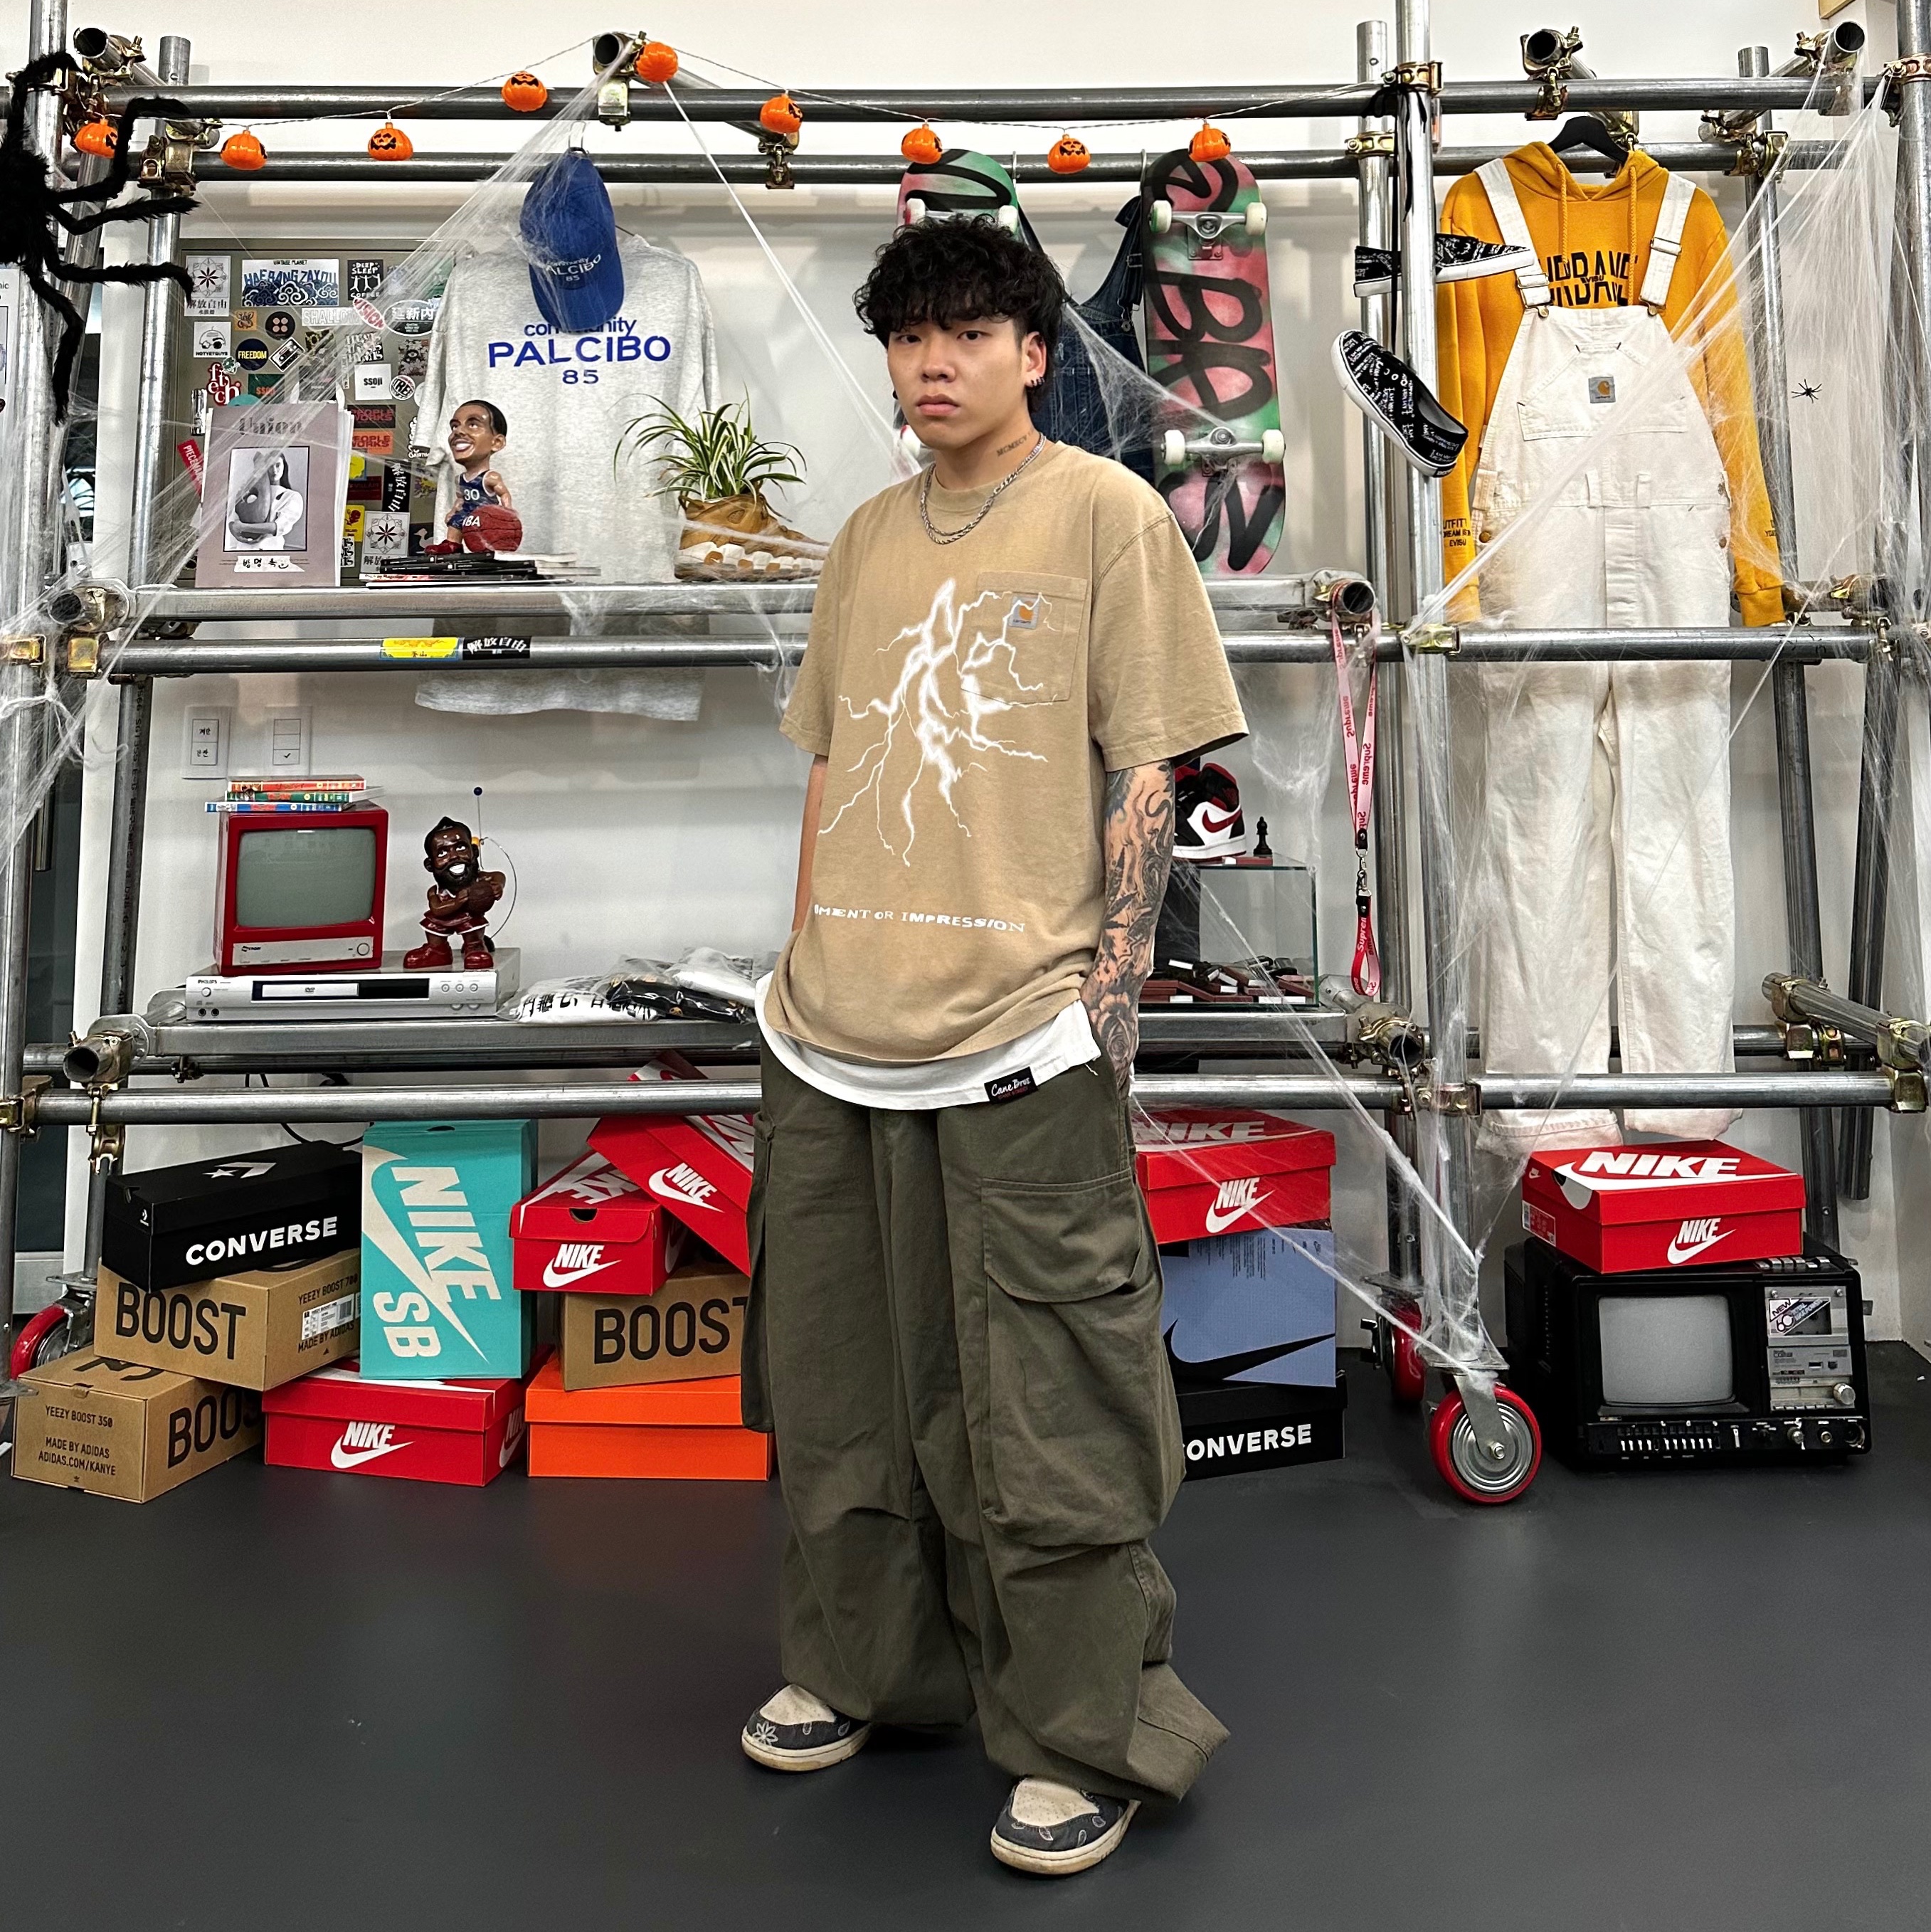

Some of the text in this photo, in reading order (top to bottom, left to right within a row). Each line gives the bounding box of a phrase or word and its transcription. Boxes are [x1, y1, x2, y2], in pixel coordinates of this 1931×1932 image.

[546, 253, 601, 275] ALCIBO
[303, 308, 359, 325] SHALLO
[524, 317, 638, 337] conity
[238, 350, 267, 359] FREEDOM
[488, 336, 671, 368] PALCIBO
[562, 369, 599, 384] 85
[463, 489, 480, 501] 30
[901, 911, 1025, 932] IMPRESSION
[991, 1083, 1013, 1097] Cane
[1580, 1151, 1741, 1179] NIKE
[665, 1162, 717, 1204] NIKE
[1215, 1177, 1260, 1210] NIKE
[185, 1216, 338, 1266] CONVERSE
[391, 1166, 502, 1304] NIKE
[1677, 1218, 1721, 1244] NIKE
[555, 1244, 605, 1269] NIKE
[298, 1287, 321, 1305] YEEZY
[322, 1278, 344, 1296] BOOST
[1772, 1299, 1792, 1316] NEW
[115, 1282, 246, 1360] BOOST
[372, 1291, 442, 1358] SB
[45, 1405, 114, 1428] YEEZY BOOST 350
[45, 1436, 110, 1459] MADE BY ADIDAS
[343, 1421, 396, 1450] NIKE
[38, 1450, 116, 1476] ADIDAS.COM/KANYE
